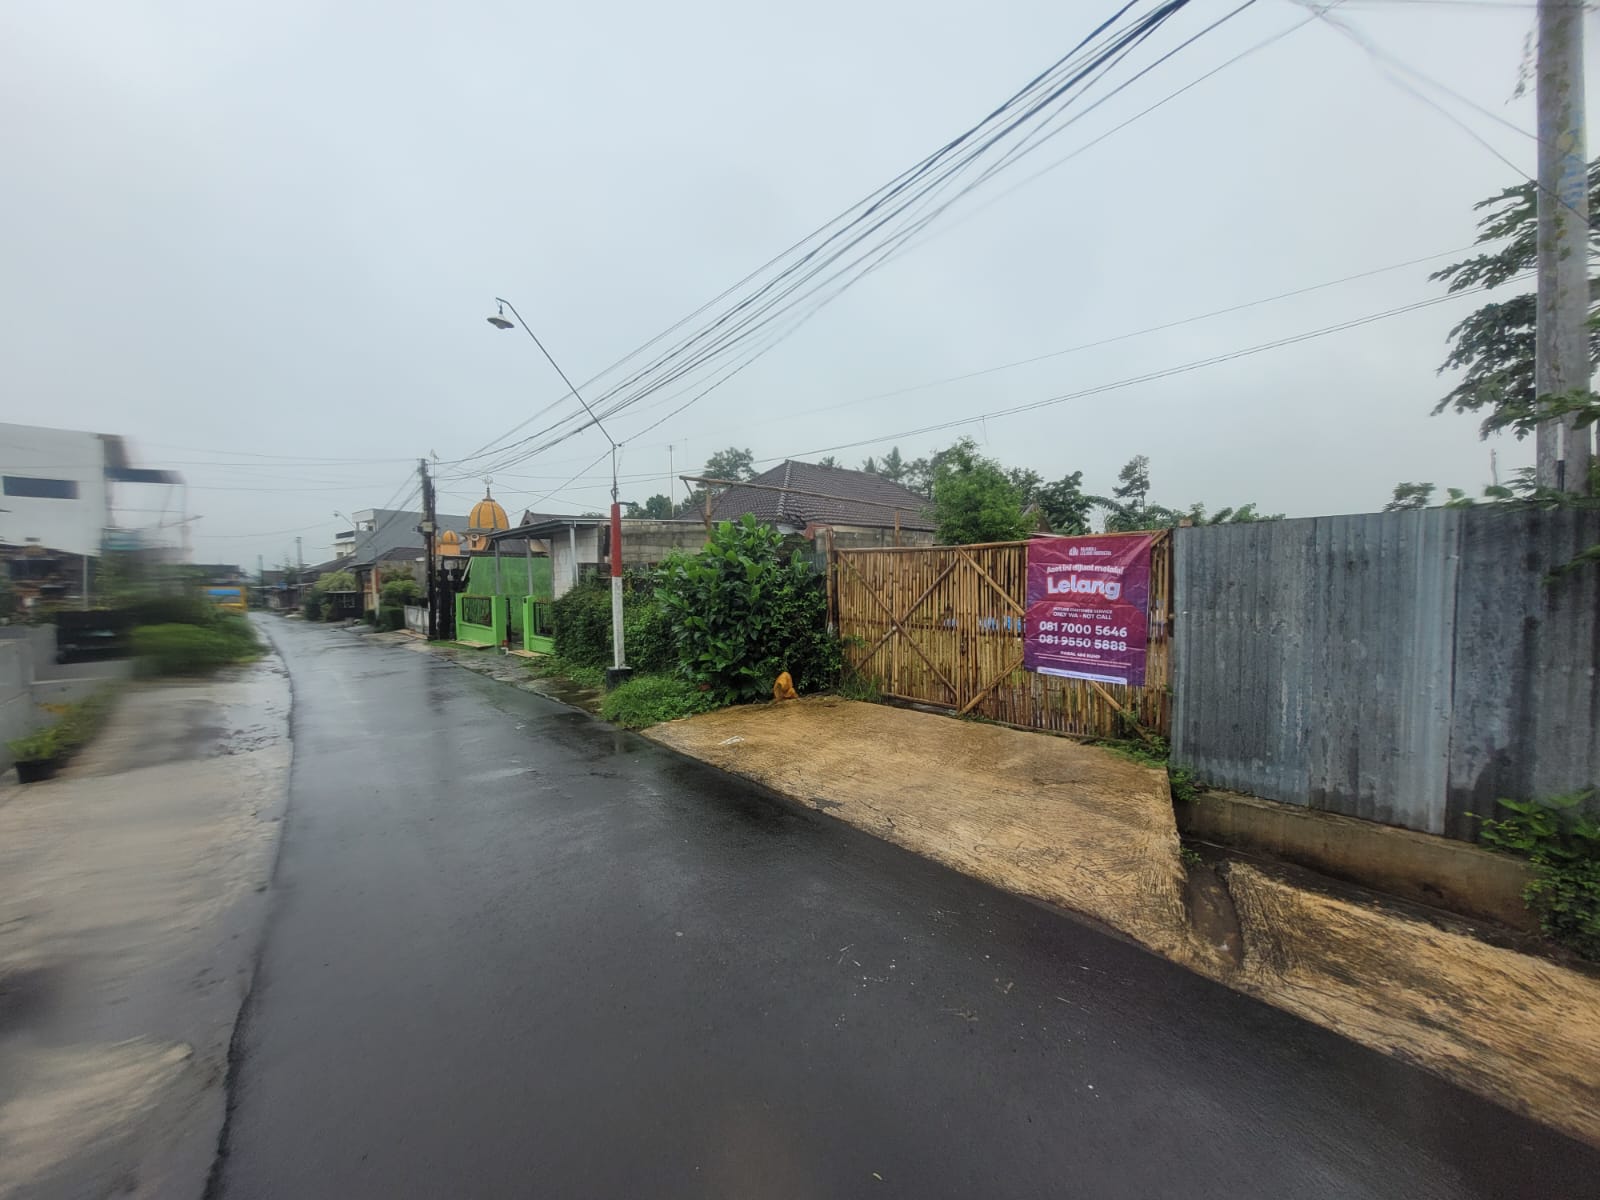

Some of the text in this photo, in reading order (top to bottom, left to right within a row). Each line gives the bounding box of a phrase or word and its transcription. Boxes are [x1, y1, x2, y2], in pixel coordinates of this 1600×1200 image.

[1047, 575, 1121, 600] Lelang
[1039, 621, 1127, 638] 081 7000 5646
[1039, 634, 1127, 651] 081 9550 5888
